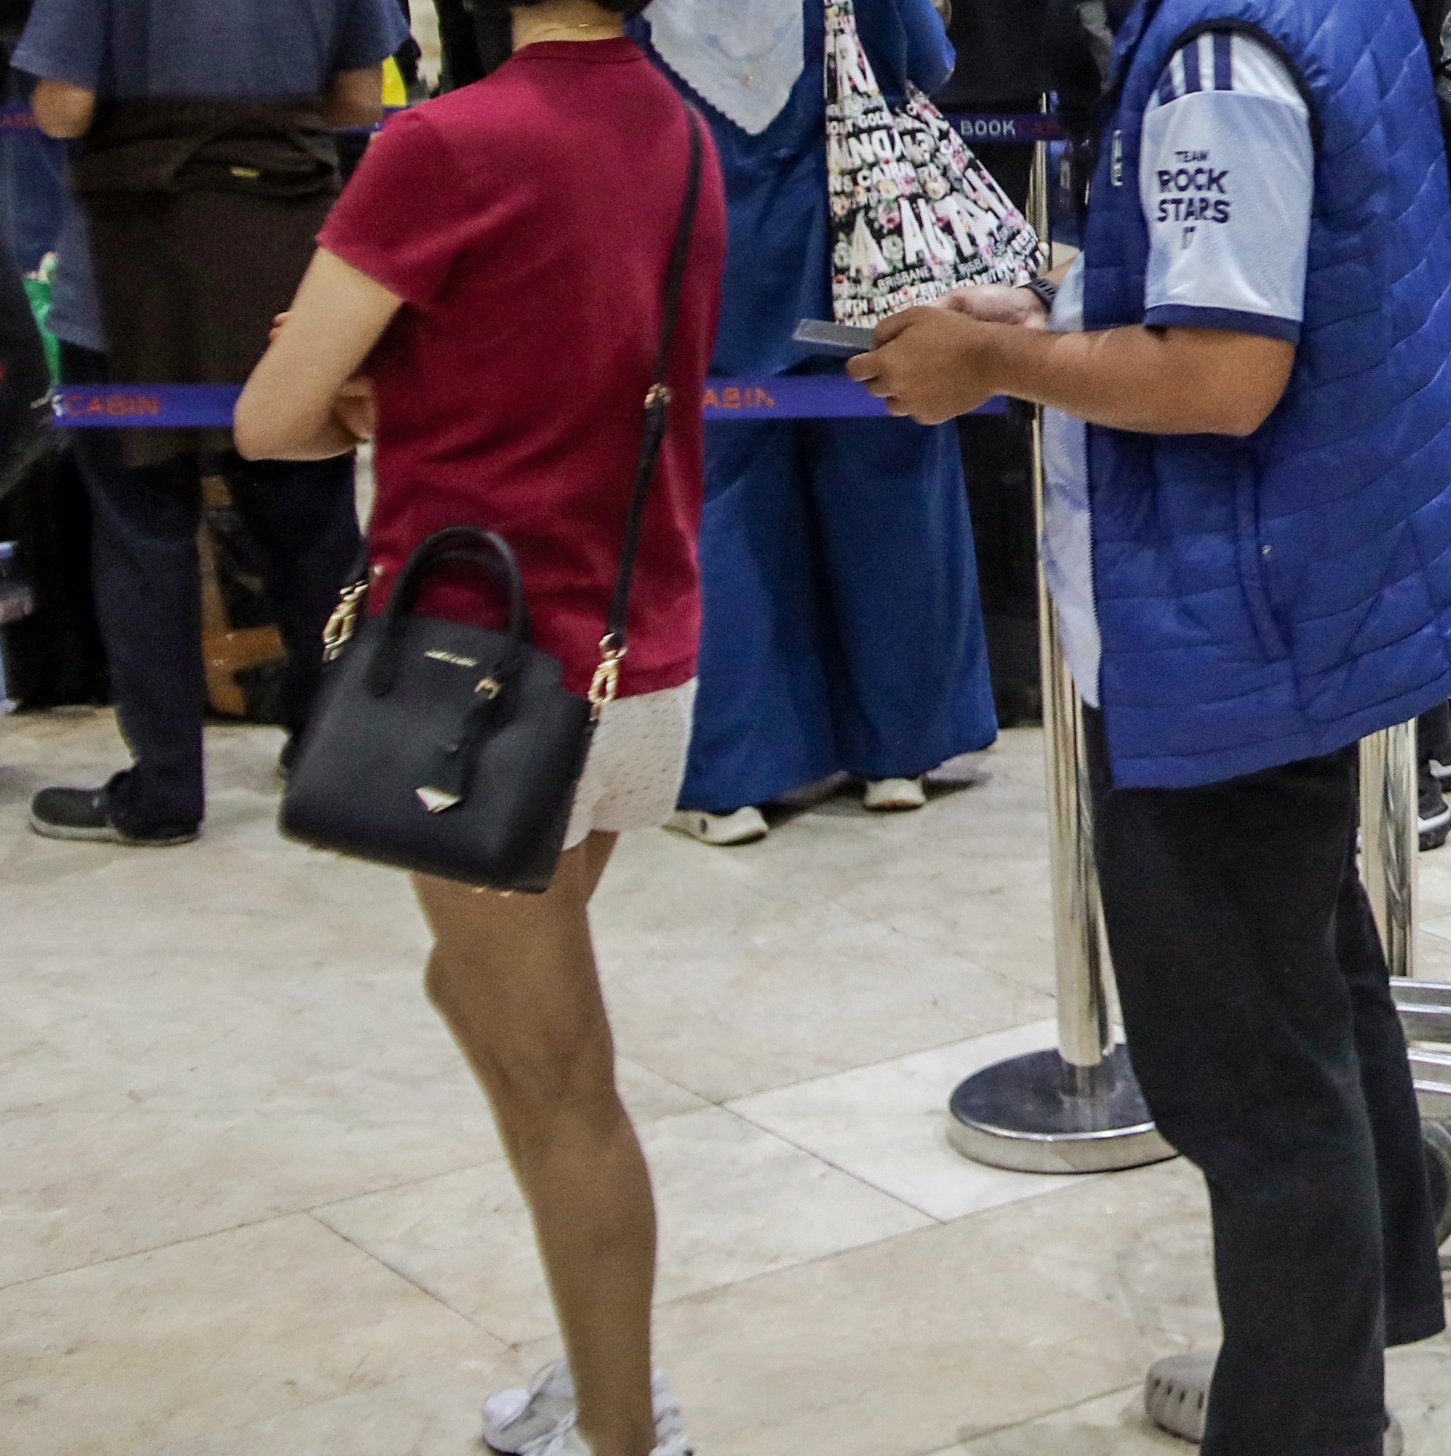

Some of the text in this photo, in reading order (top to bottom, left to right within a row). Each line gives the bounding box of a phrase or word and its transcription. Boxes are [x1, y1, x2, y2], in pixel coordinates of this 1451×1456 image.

[960, 119, 1016, 137] BOOK
[1174, 149, 1210, 163] TEAM
[1157, 168, 1230, 194] ROCK
[1156, 197, 1232, 224] STARS
[66, 394, 161, 417] CABIN
[701, 386, 777, 410] ABIN
